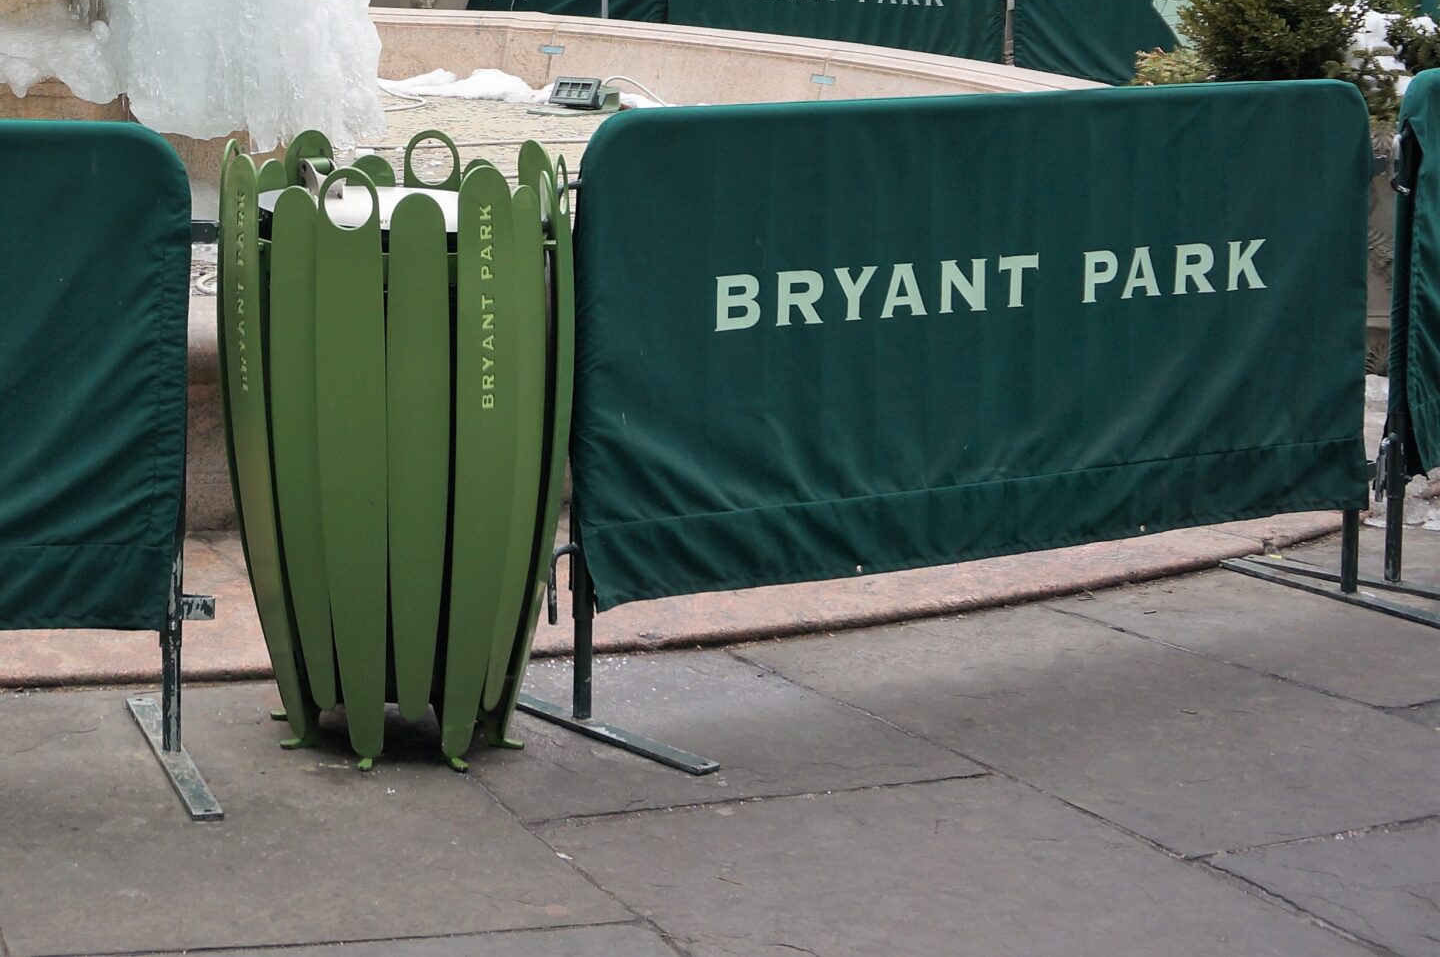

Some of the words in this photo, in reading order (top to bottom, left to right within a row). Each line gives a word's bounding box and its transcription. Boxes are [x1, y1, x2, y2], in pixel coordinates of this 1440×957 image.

[478, 202, 494, 281] PARK
[714, 251, 1040, 332] BRYANT
[1081, 238, 1268, 304] PARK
[480, 294, 496, 410] BRYANT
